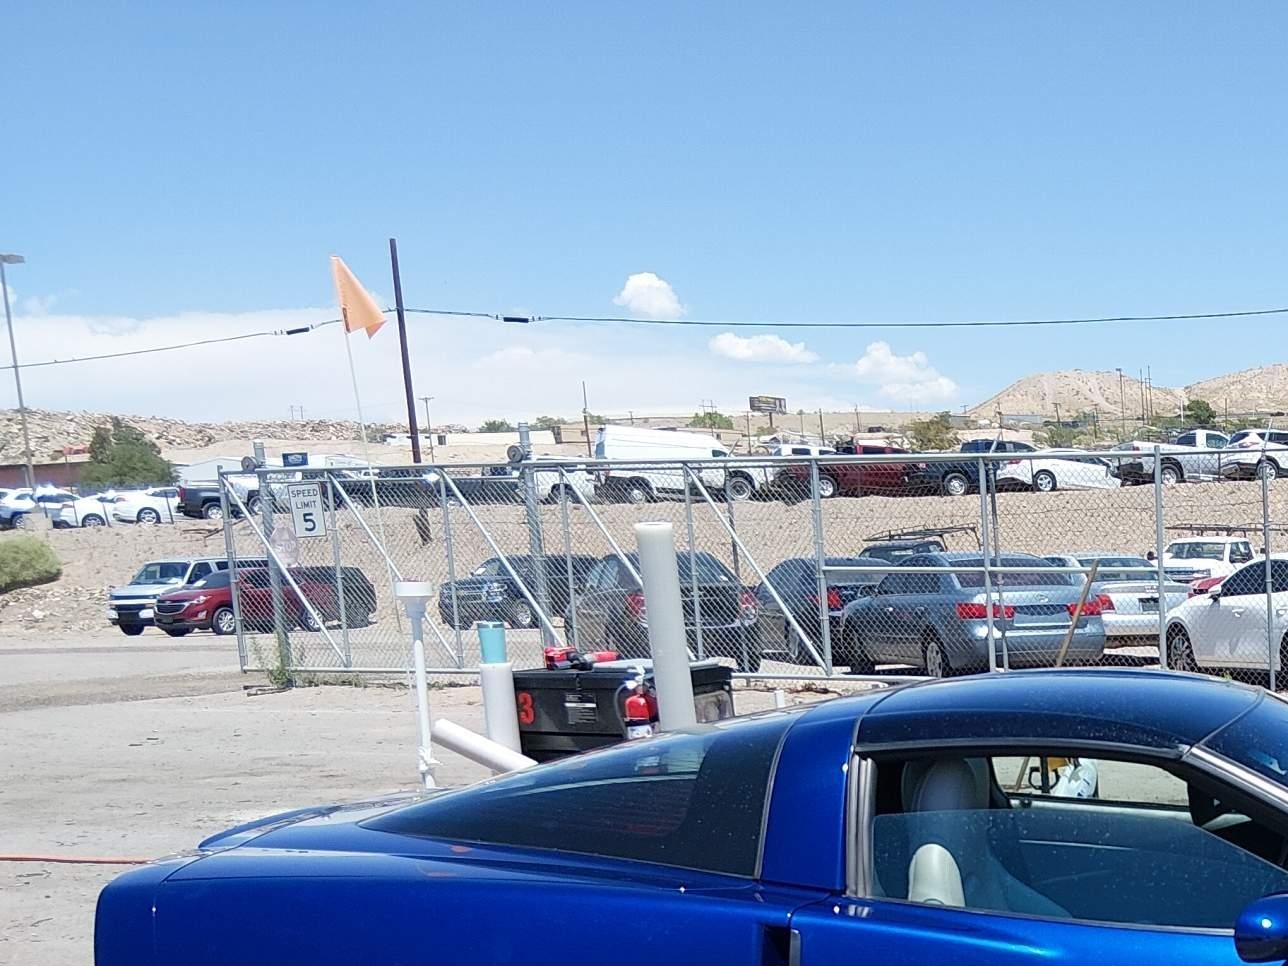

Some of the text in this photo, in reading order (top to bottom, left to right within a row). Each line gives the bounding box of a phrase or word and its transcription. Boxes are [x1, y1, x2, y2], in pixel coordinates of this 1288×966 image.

[291, 489, 318, 498] SPEED
[296, 500, 317, 510] LIMIT
[303, 512, 317, 532] 5
[518, 692, 534, 725] 3
